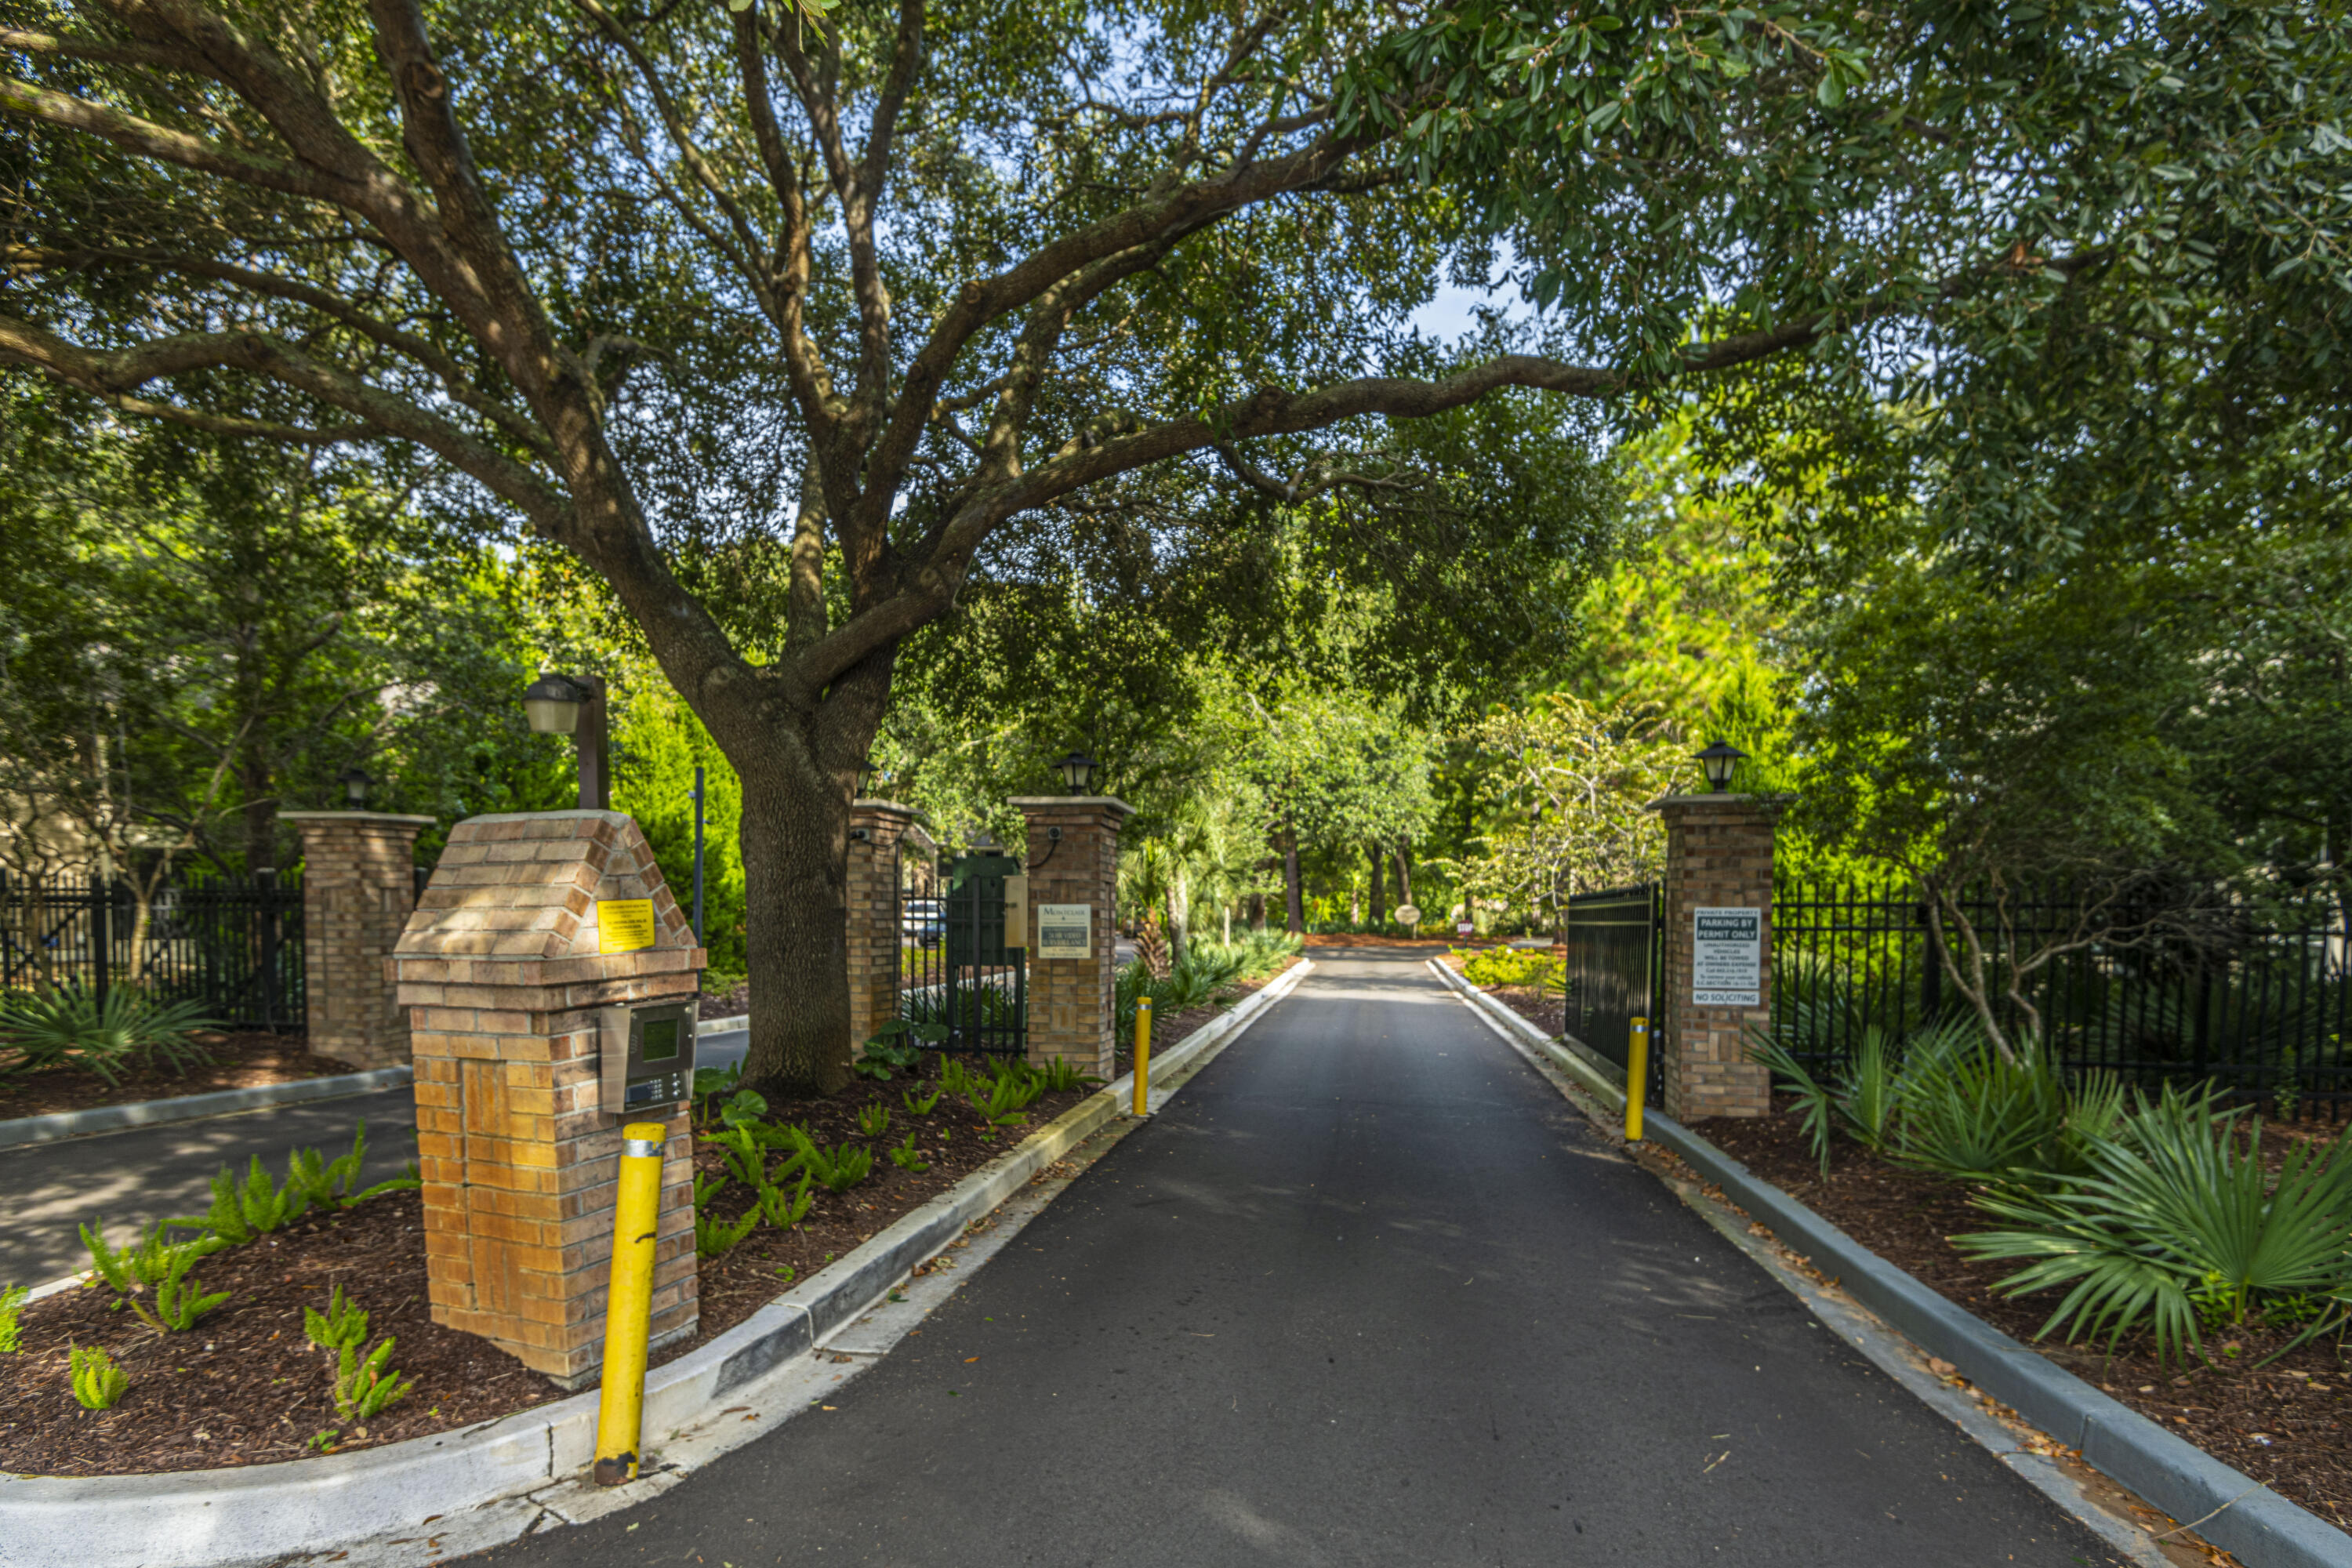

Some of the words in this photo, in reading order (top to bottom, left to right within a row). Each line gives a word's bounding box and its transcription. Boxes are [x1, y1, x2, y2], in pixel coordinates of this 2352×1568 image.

[1700, 918, 1739, 927] PARKING
[1741, 918, 1754, 927] BY
[1457, 923, 1474, 933] STOP
[1697, 930, 1730, 939] PERMIT
[1731, 930, 1756, 939] ONLY
[1711, 993, 1756, 1002] SOLICITING
